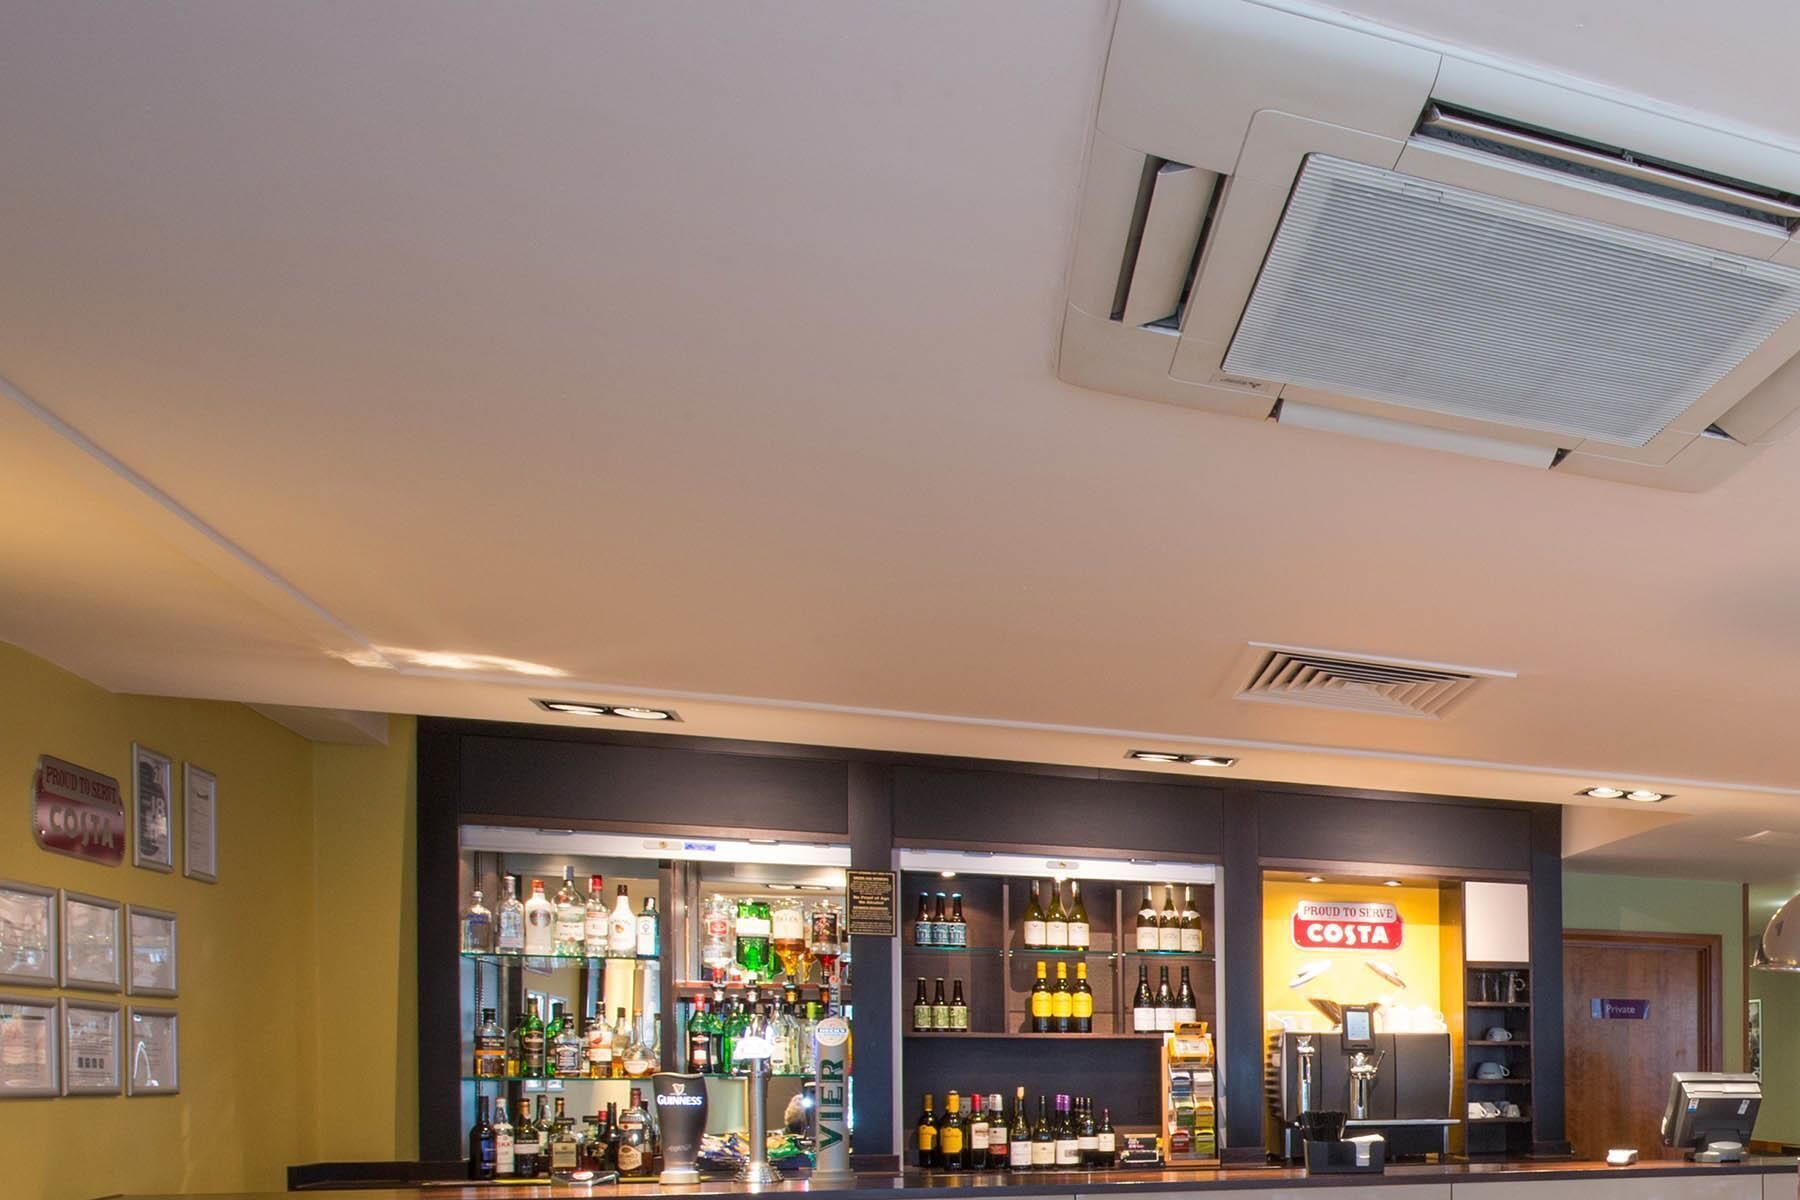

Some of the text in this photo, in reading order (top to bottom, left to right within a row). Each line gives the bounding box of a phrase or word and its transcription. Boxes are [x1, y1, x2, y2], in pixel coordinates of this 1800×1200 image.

[50, 804, 114, 849] COSTA
[1303, 905, 1340, 917] PROUD
[1342, 906, 1356, 917] TO
[1306, 923, 1390, 945] COSTA
[1606, 1004, 1636, 1014] Private
[656, 1094, 703, 1106] GUINNESS
[818, 1058, 844, 1153] VIER
